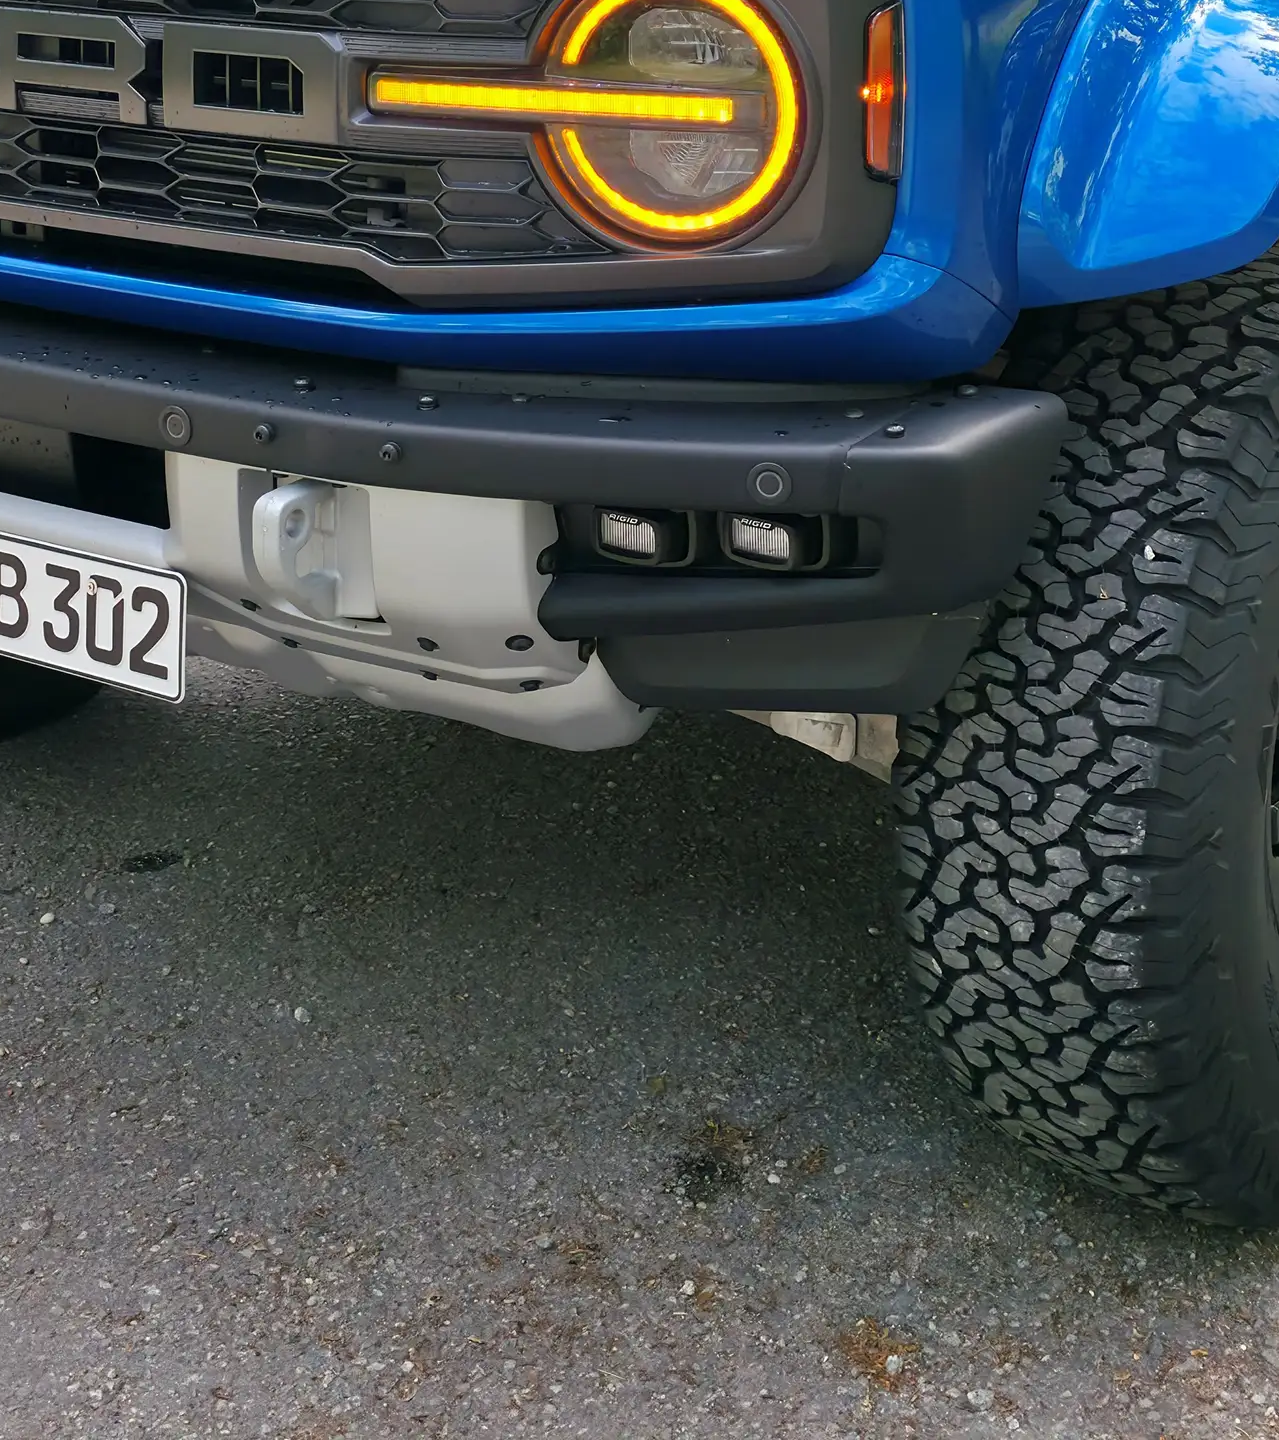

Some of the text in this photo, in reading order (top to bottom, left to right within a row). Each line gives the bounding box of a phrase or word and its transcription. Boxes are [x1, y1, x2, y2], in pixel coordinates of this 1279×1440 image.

[608, 513, 638, 525] RIGID
[741, 517, 772, 529] RIGID
[43, 563, 169, 681] 302
